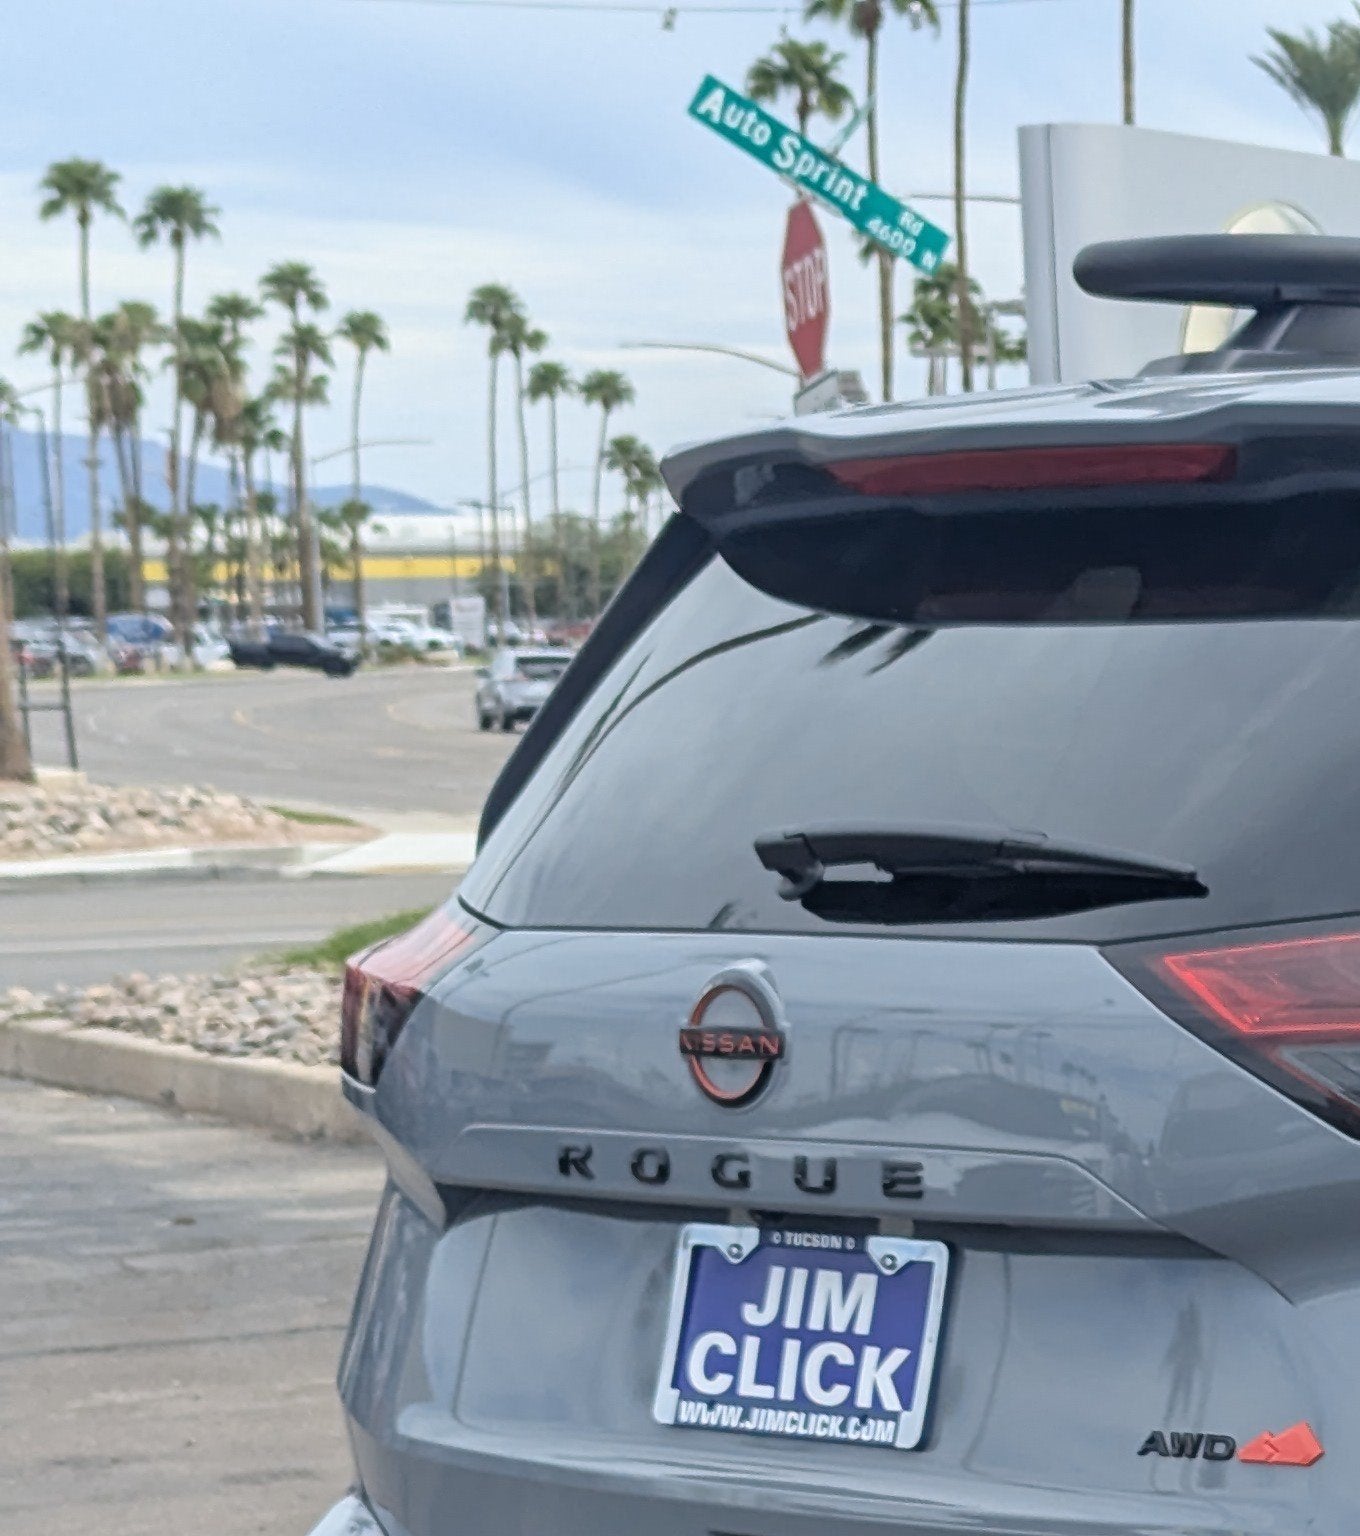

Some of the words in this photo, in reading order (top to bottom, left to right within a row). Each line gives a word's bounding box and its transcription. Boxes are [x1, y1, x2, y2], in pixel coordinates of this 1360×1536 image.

[697, 87, 772, 146] Auto
[771, 134, 869, 211] Sprint
[783, 247, 829, 332] STOP
[681, 1032, 780, 1056] NSSAN
[557, 1144, 924, 1200] ROGUE
[785, 1231, 842, 1250] TUCSON
[742, 1265, 878, 1336] JIM
[688, 1331, 911, 1412] CLICK
[679, 1400, 896, 1443] WWW.JIMCLICK.COM
[1137, 1430, 1237, 1461] AWD
